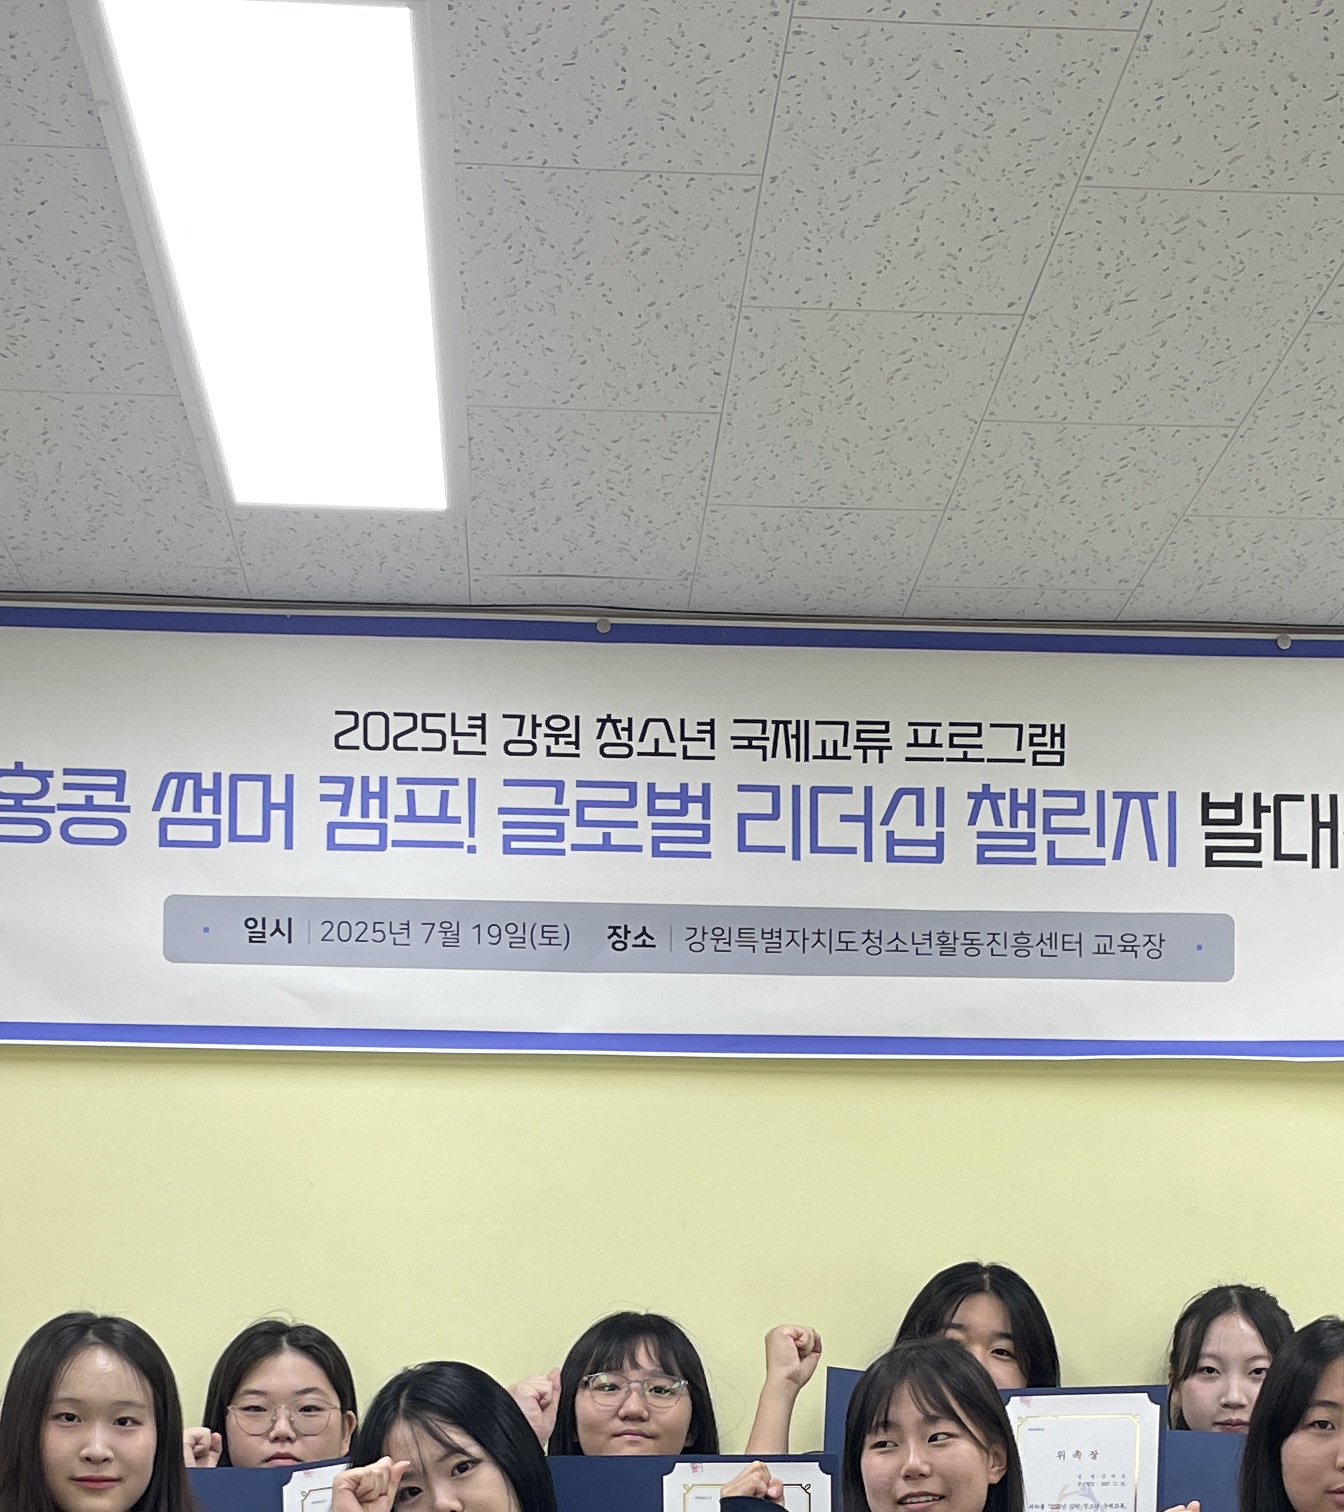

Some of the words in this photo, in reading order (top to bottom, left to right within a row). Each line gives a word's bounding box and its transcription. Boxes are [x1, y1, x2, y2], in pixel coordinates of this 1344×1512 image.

[334, 710, 486, 756] 2025년
[502, 714, 580, 758] 강원
[596, 714, 717, 760] 청소년
[730, 719, 893, 764] 국제교류
[905, 722, 1066, 766] 프로그램
[151, 772, 295, 850] 썸머
[319, 776, 478, 854] 캠프!
[498, 779, 713, 859] 글로벌
[737, 784, 946, 864] 리더십
[967, 783, 1178, 867] 챌린지
[244, 917, 293, 944] 일시
[320, 920, 411, 947] 2025년
[421, 921, 461, 949] 7월
[472, 922, 570, 951] 19일(토)
[607, 924, 657, 951] 장소
[684, 925, 1083, 958] 강원특별자치도청소년활동진흥센터
[1092, 932, 1167, 959] 교육장
